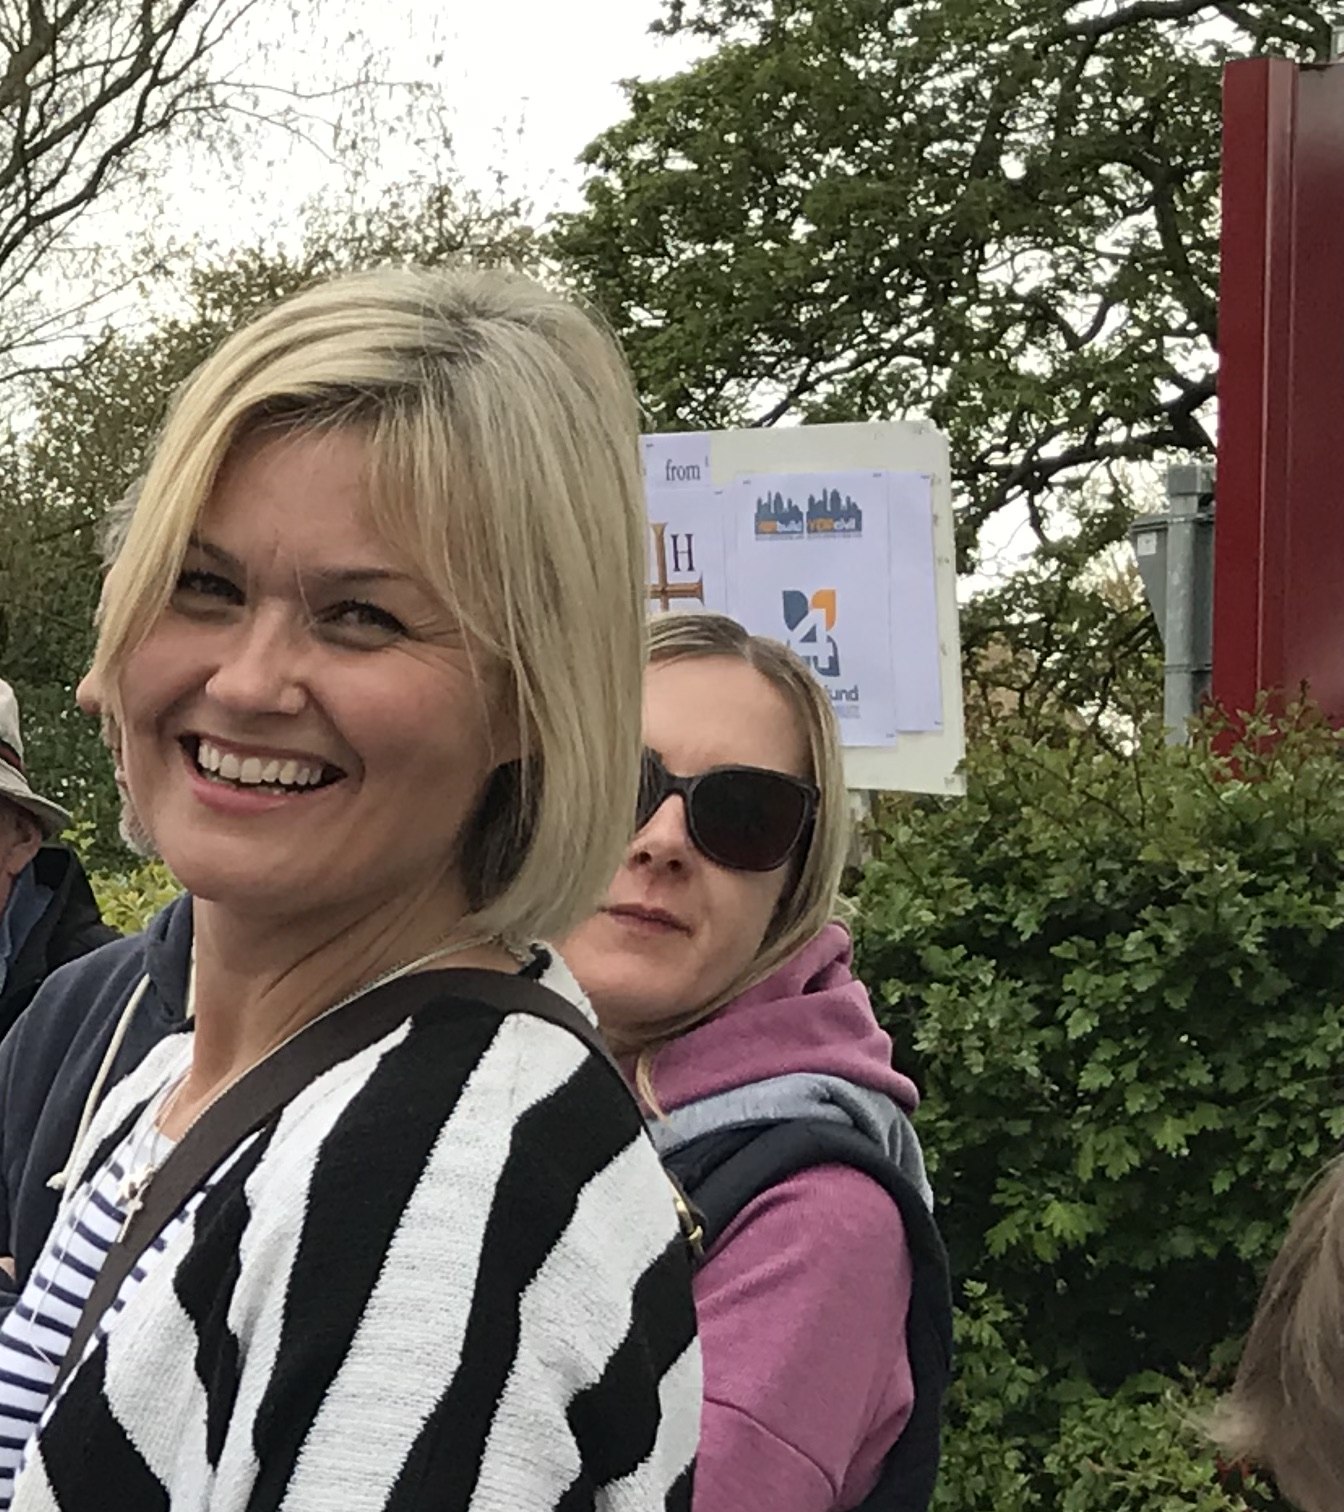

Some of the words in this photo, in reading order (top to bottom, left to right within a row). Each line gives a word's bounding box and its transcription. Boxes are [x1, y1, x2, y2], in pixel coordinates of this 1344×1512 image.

[665, 458, 701, 482] from
[670, 533, 696, 573] H
[824, 685, 859, 701] und
